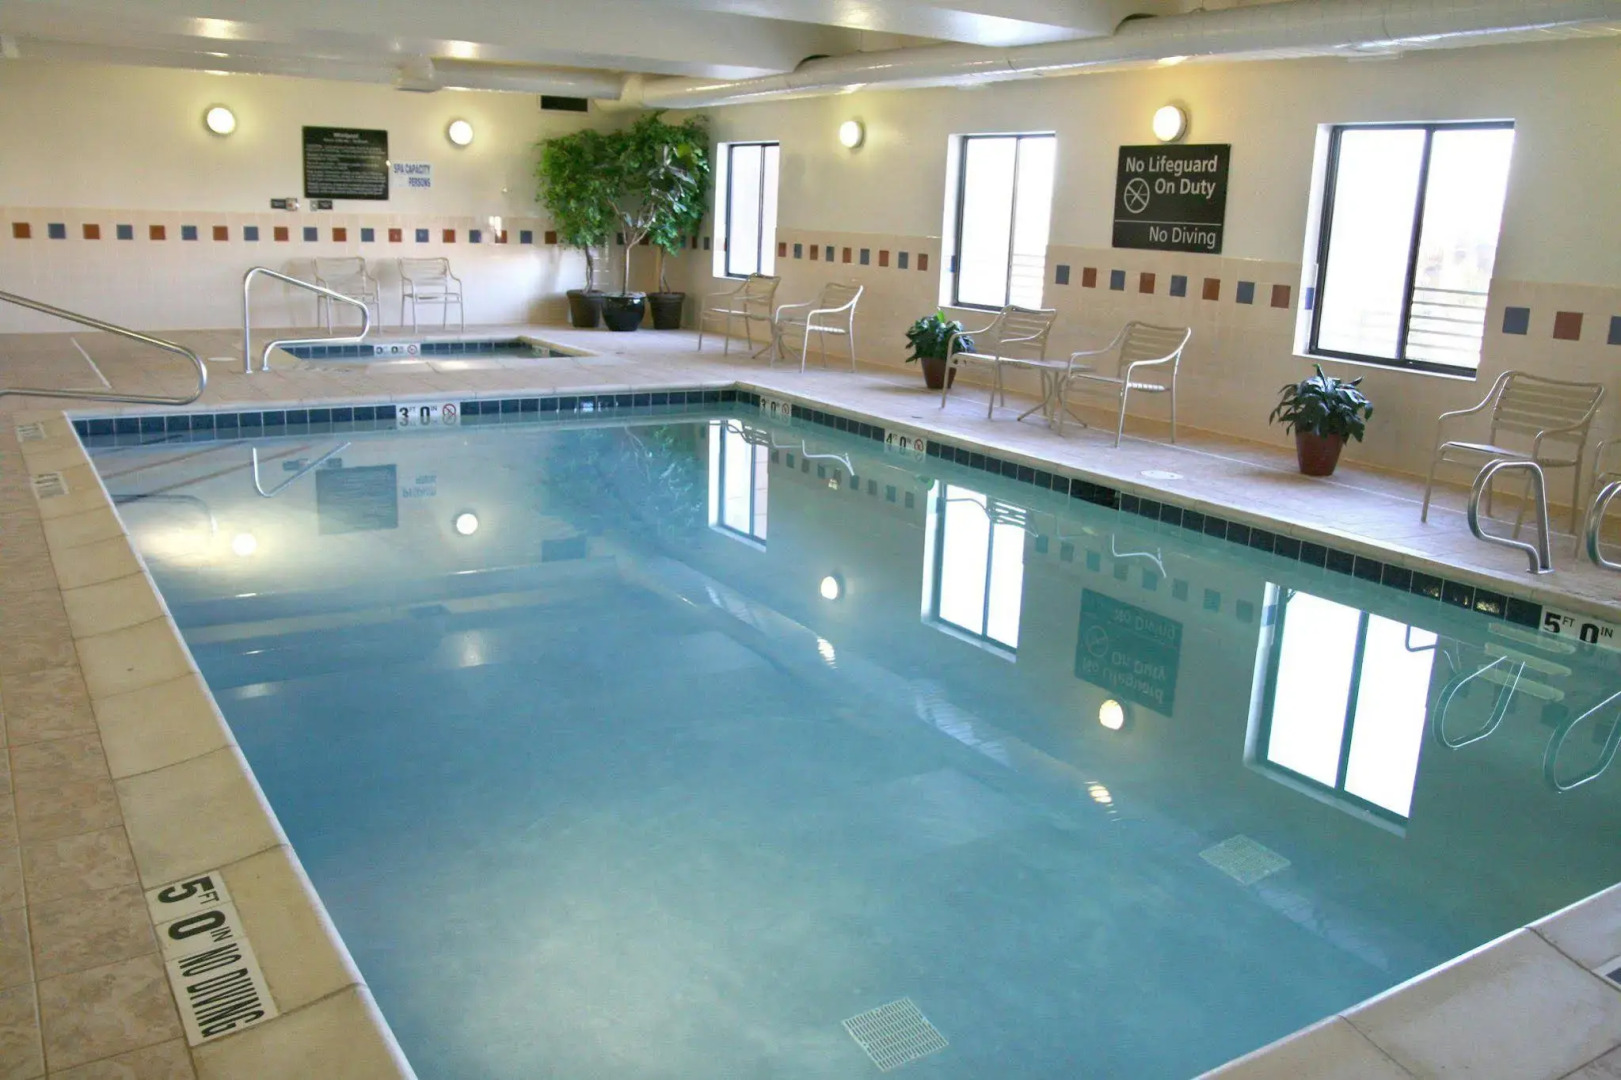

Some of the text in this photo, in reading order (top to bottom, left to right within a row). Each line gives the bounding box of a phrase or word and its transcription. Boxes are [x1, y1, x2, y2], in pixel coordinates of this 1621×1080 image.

[1126, 155, 1218, 176] No Lifeguard
[1155, 178, 1216, 199] On Duty
[1149, 226, 1216, 249] No Diving
[178, 943, 242, 977] NO
[186, 967, 265, 1038] DIVING
